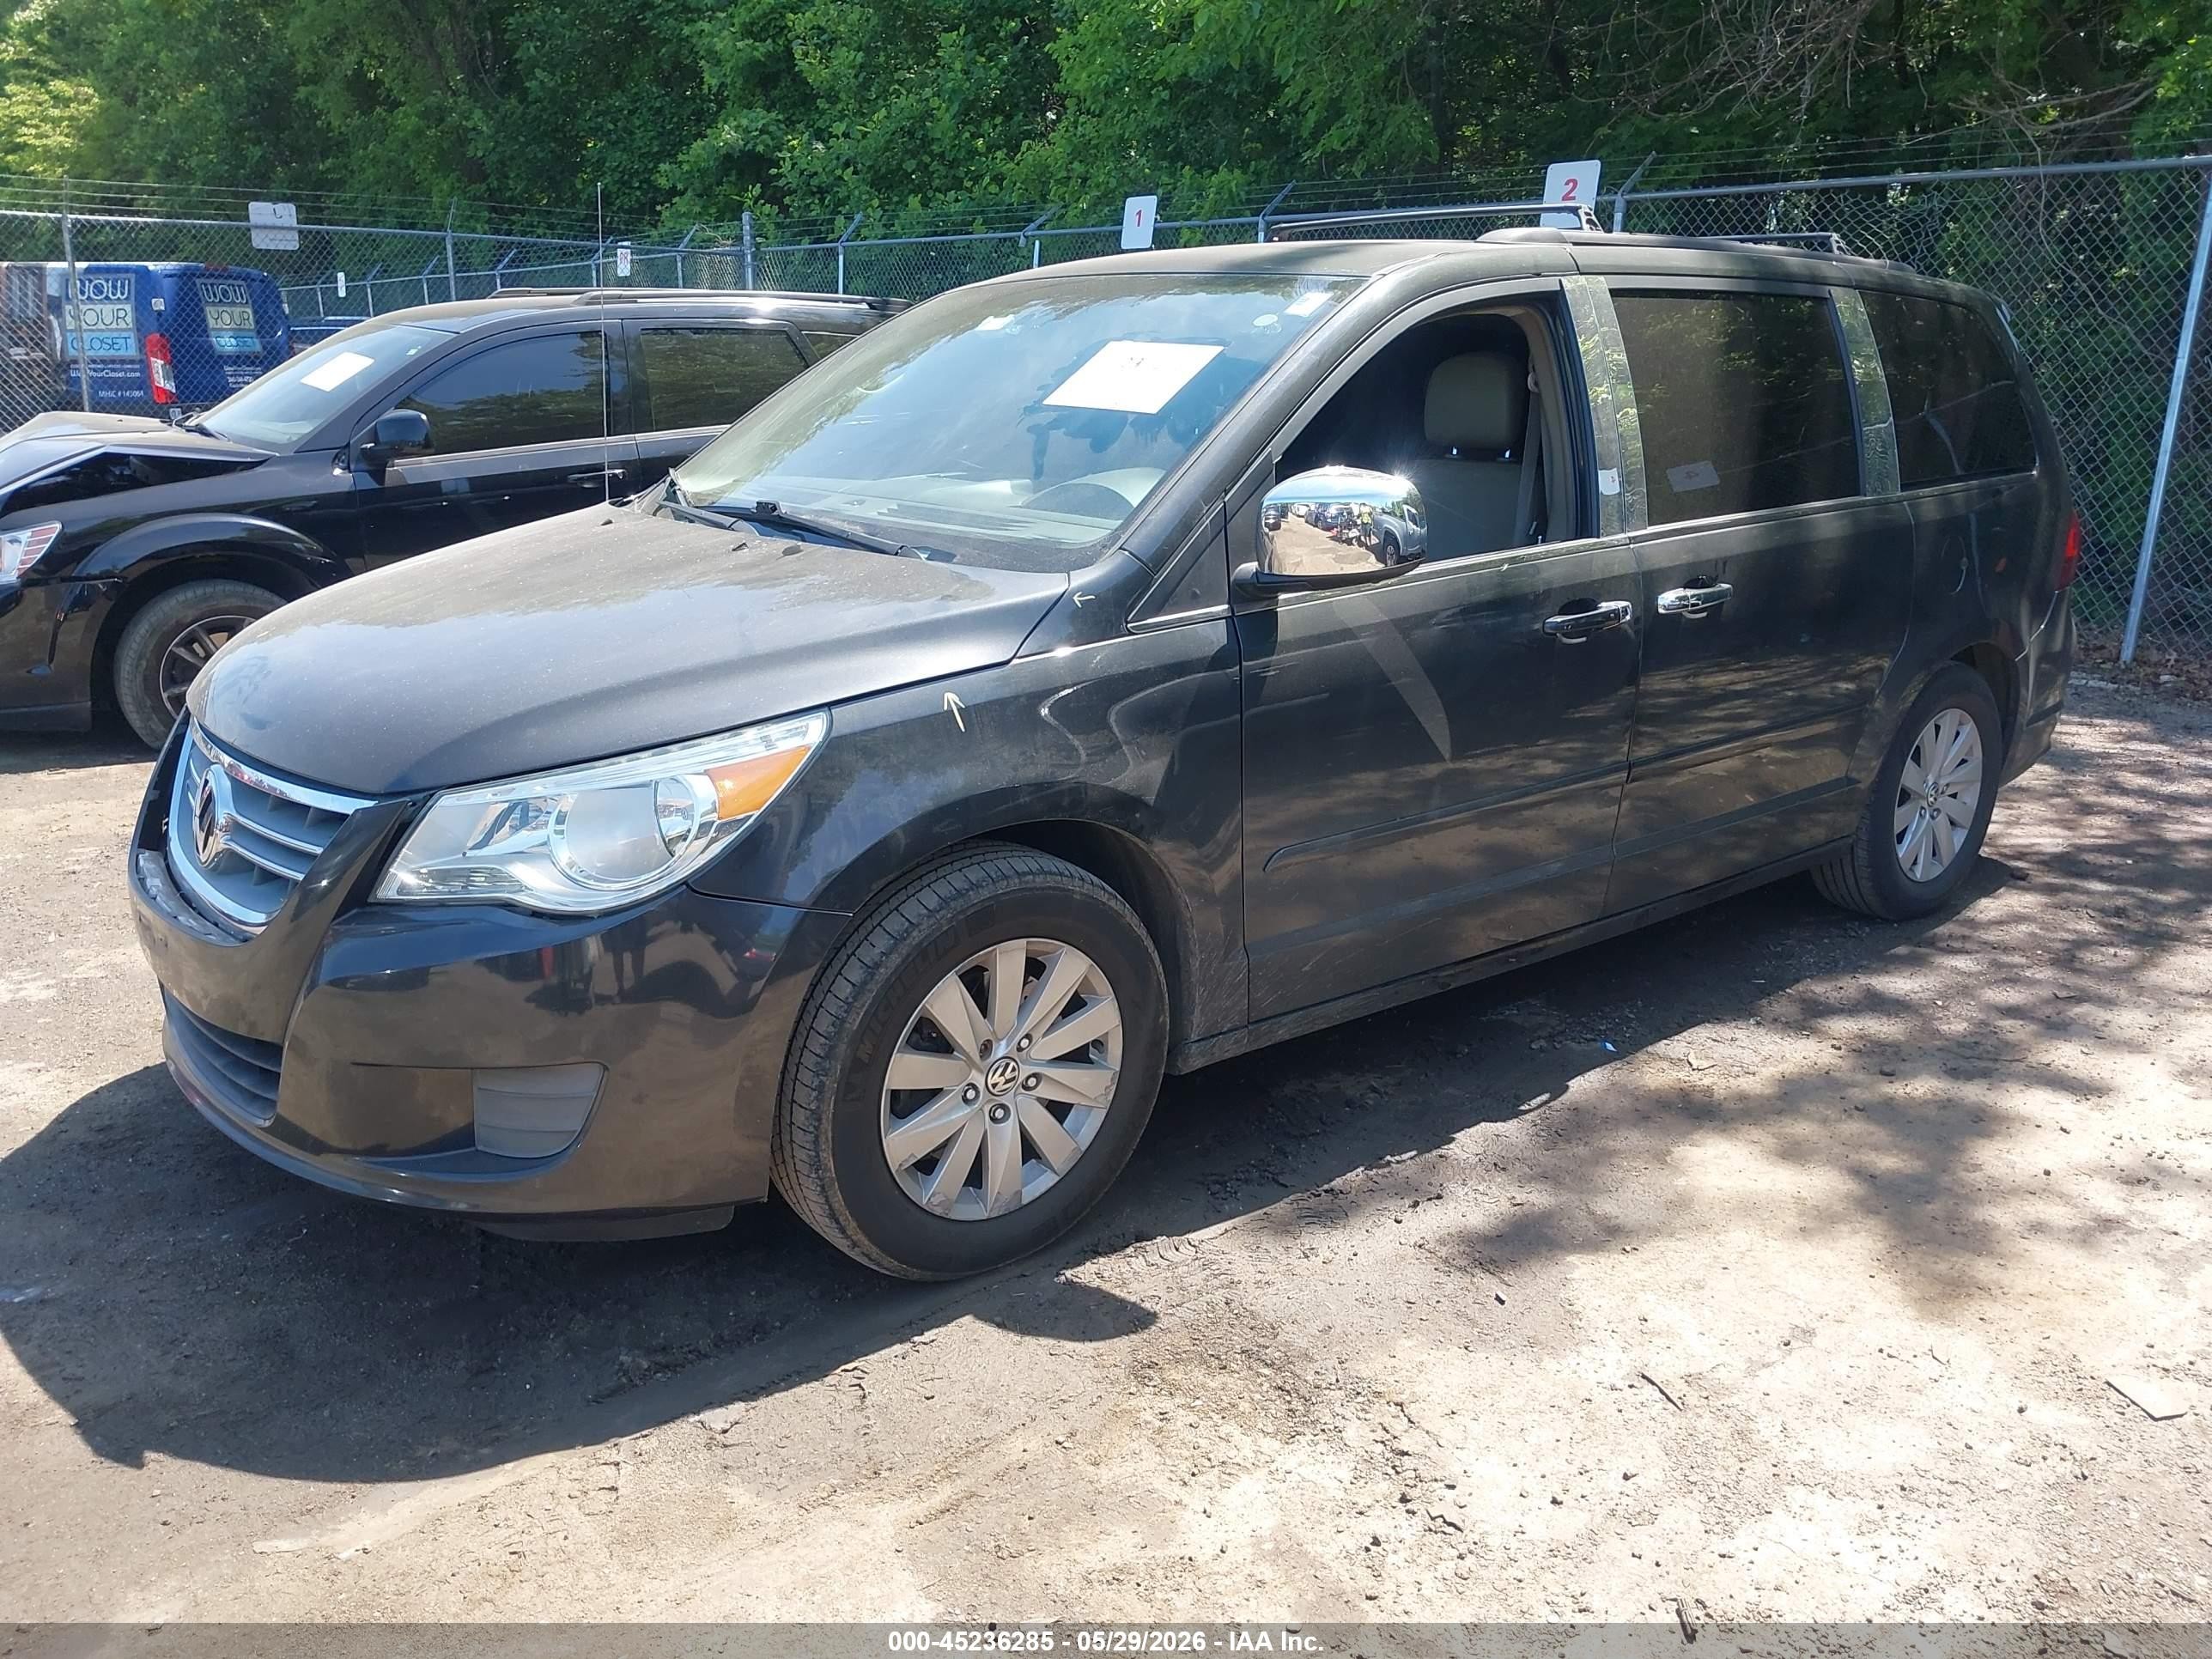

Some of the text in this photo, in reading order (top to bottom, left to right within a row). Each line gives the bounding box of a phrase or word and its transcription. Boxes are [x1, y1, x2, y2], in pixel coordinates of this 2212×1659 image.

[1561, 178, 1578, 202] 2
[1135, 209, 1143, 228] 1
[201, 283, 247, 304] WOW
[209, 309, 253, 326] YOUR
